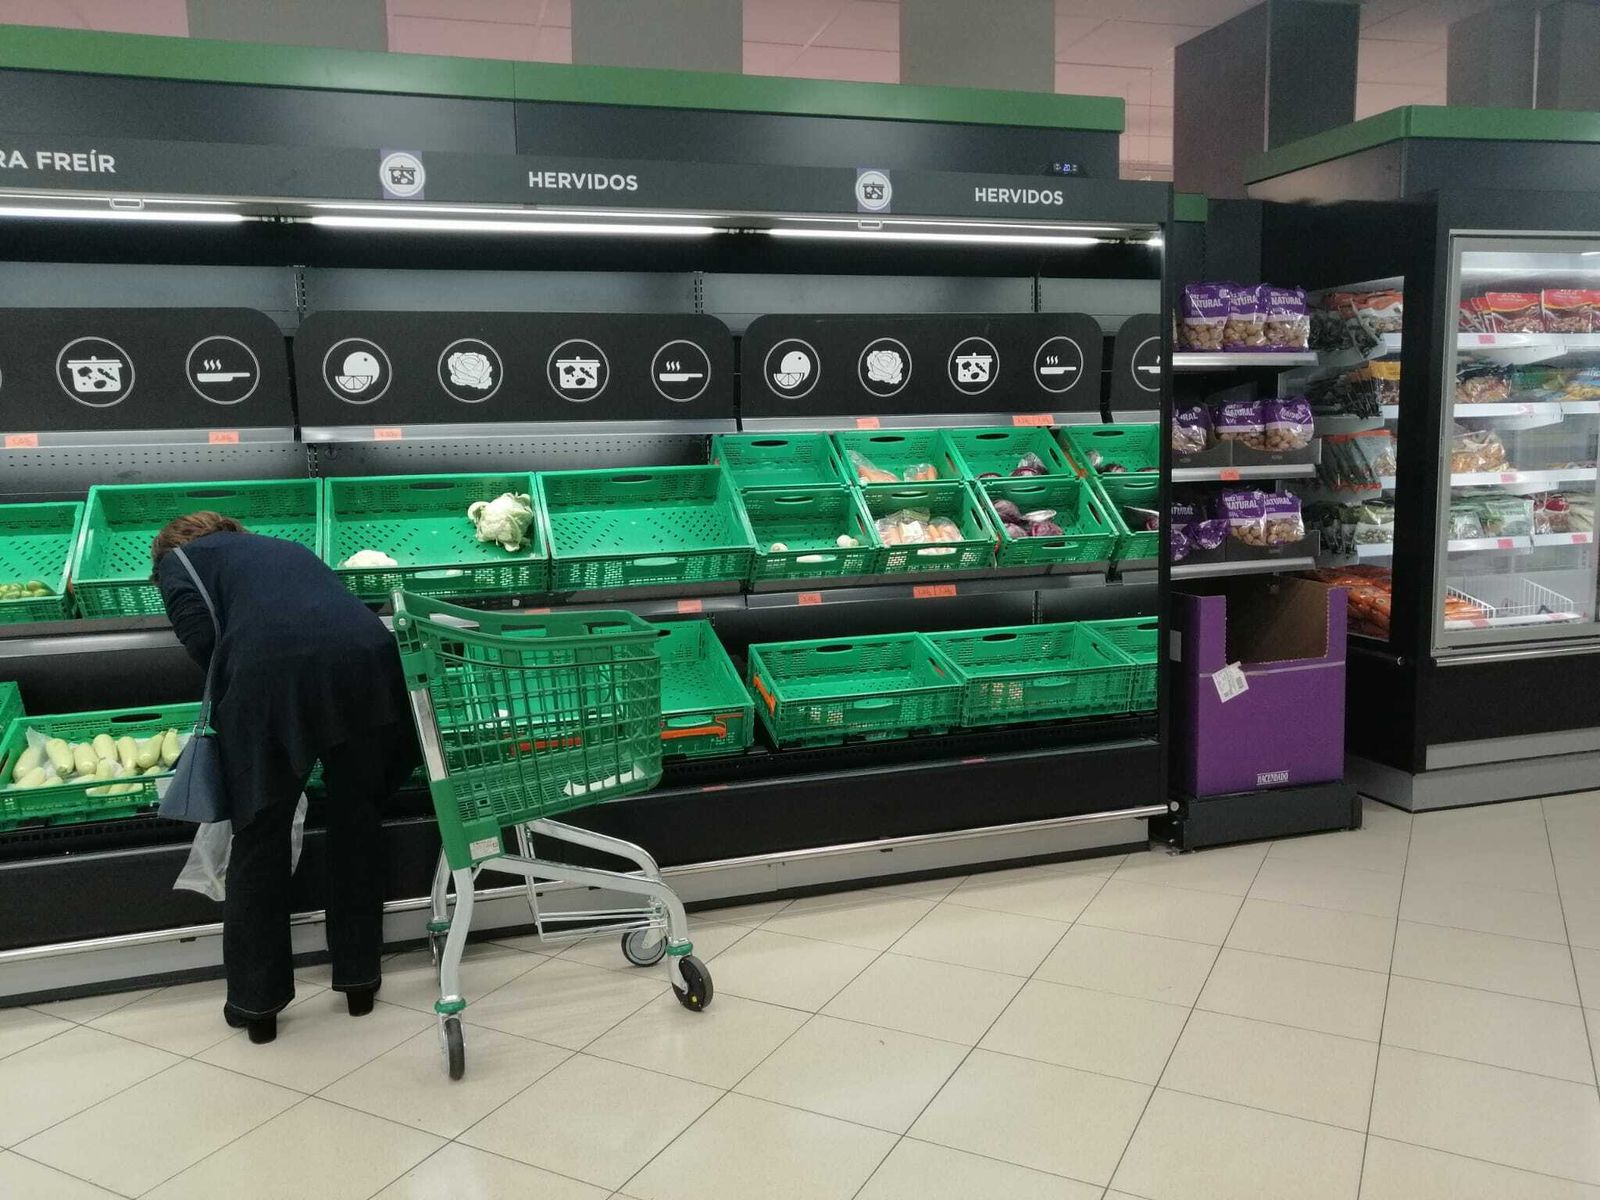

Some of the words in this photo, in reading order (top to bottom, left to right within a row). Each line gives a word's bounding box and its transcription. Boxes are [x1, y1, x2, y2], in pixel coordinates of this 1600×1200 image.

[36, 149, 116, 173] FREÍR
[528, 171, 638, 191] HERVIDOS
[975, 187, 1064, 205] HERVIDOS
[1270, 296, 1303, 306] NATURAL
[1226, 499, 1259, 510] NATURAL
